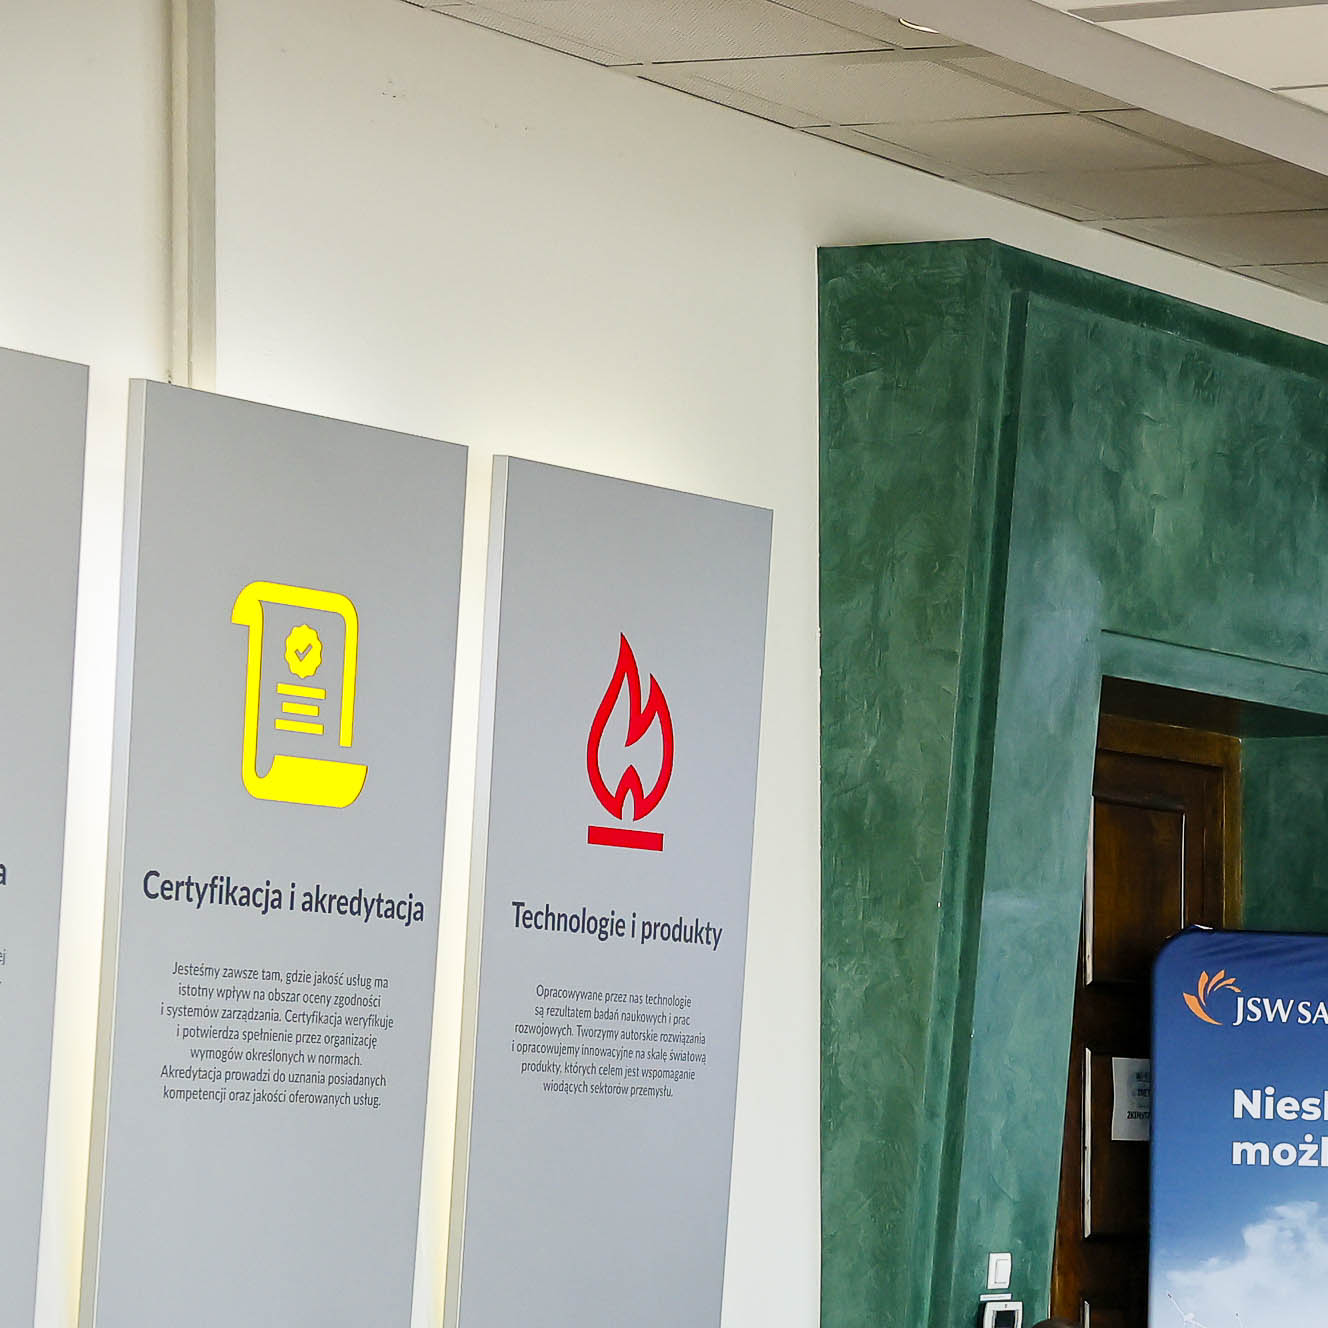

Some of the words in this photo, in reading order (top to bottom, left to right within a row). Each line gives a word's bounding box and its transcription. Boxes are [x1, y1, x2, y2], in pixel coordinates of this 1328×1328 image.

[143, 870, 283, 915] Certyfikacja
[289, 882, 296, 911] i
[301, 885, 425, 927] akredytacja
[511, 901, 626, 941] Technologie
[631, 912, 637, 939] i
[640, 916, 723, 951] produkty
[172, 961, 220, 979] Jesteśmy
[222, 967, 259, 981] zawsze
[261, 968, 283, 983] tam,
[285, 971, 312, 985] gdzie
[313, 972, 344, 987] jakość
[346, 975, 372, 990] usług
[374, 977, 389, 989] ma
[178, 982, 214, 1000] istotny
[216, 986, 251, 1001] wpływ
[253, 989, 265, 1001] na
[268, 990, 300, 1003] obszar
[302, 993, 332, 1006] oceny
[333, 994, 381, 1009] zgodności
[536, 984, 603, 1002] Opracowywane
[604, 992, 627, 1004] przez
[629, 993, 643, 1005] nas
[645, 992, 692, 1009] technologie
[166, 1005, 220, 1019] systemów
[221, 1007, 282, 1024] zarządzania.
[284, 1009, 342, 1027] Certyfikacja
[344, 1013, 394, 1030] weryfikuje
[534, 1005, 544, 1019] są
[546, 1005, 592, 1019] rezultatem
[593, 1007, 619, 1021] badań
[620, 1011, 667, 1025] naukowych
[673, 1014, 691, 1027] prac
[182, 1025, 240, 1041] potwierdza
[242, 1028, 293, 1045] spełnienie
[295, 1032, 322, 1045] przez
[324, 1034, 378, 1050] organizację
[514, 1022, 574, 1038] rozwojowych.
[576, 1024, 619, 1041] Tworzymy
[620, 1027, 658, 1042] autorskie
[659, 1031, 706, 1046] rozwiązania
[190, 1048, 244, 1062] wymogów
[245, 1049, 305, 1065] określonych
[318, 1052, 363, 1067] normach.
[516, 1043, 580, 1057] opracowujemy
[581, 1045, 633, 1061] innowacyjne
[635, 1048, 645, 1059] na
[647, 1047, 668, 1062] skalę
[669, 1048, 707, 1065] światową
[160, 1064, 222, 1082] Akredytacja
[224, 1067, 271, 1083] prowadzi
[272, 1069, 286, 1083] do
[288, 1071, 325, 1085] uznania
[328, 1072, 386, 1088] posiadanych
[564, 1061, 597, 1077] których
[598, 1064, 623, 1077] celem
[624, 1065, 640, 1079] jest
[641, 1068, 696, 1082] wspomaganie
[163, 1085, 227, 1104] kompetencji
[228, 1090, 251, 1102] oraz
[252, 1088, 287, 1105] jakości
[288, 1089, 351, 1106] oferowanych
[353, 1093, 381, 1109] usług.
[543, 1080, 588, 1095] wiodących
[590, 1082, 629, 1095] sektorów
[630, 1084, 674, 1099] przemysłu.
